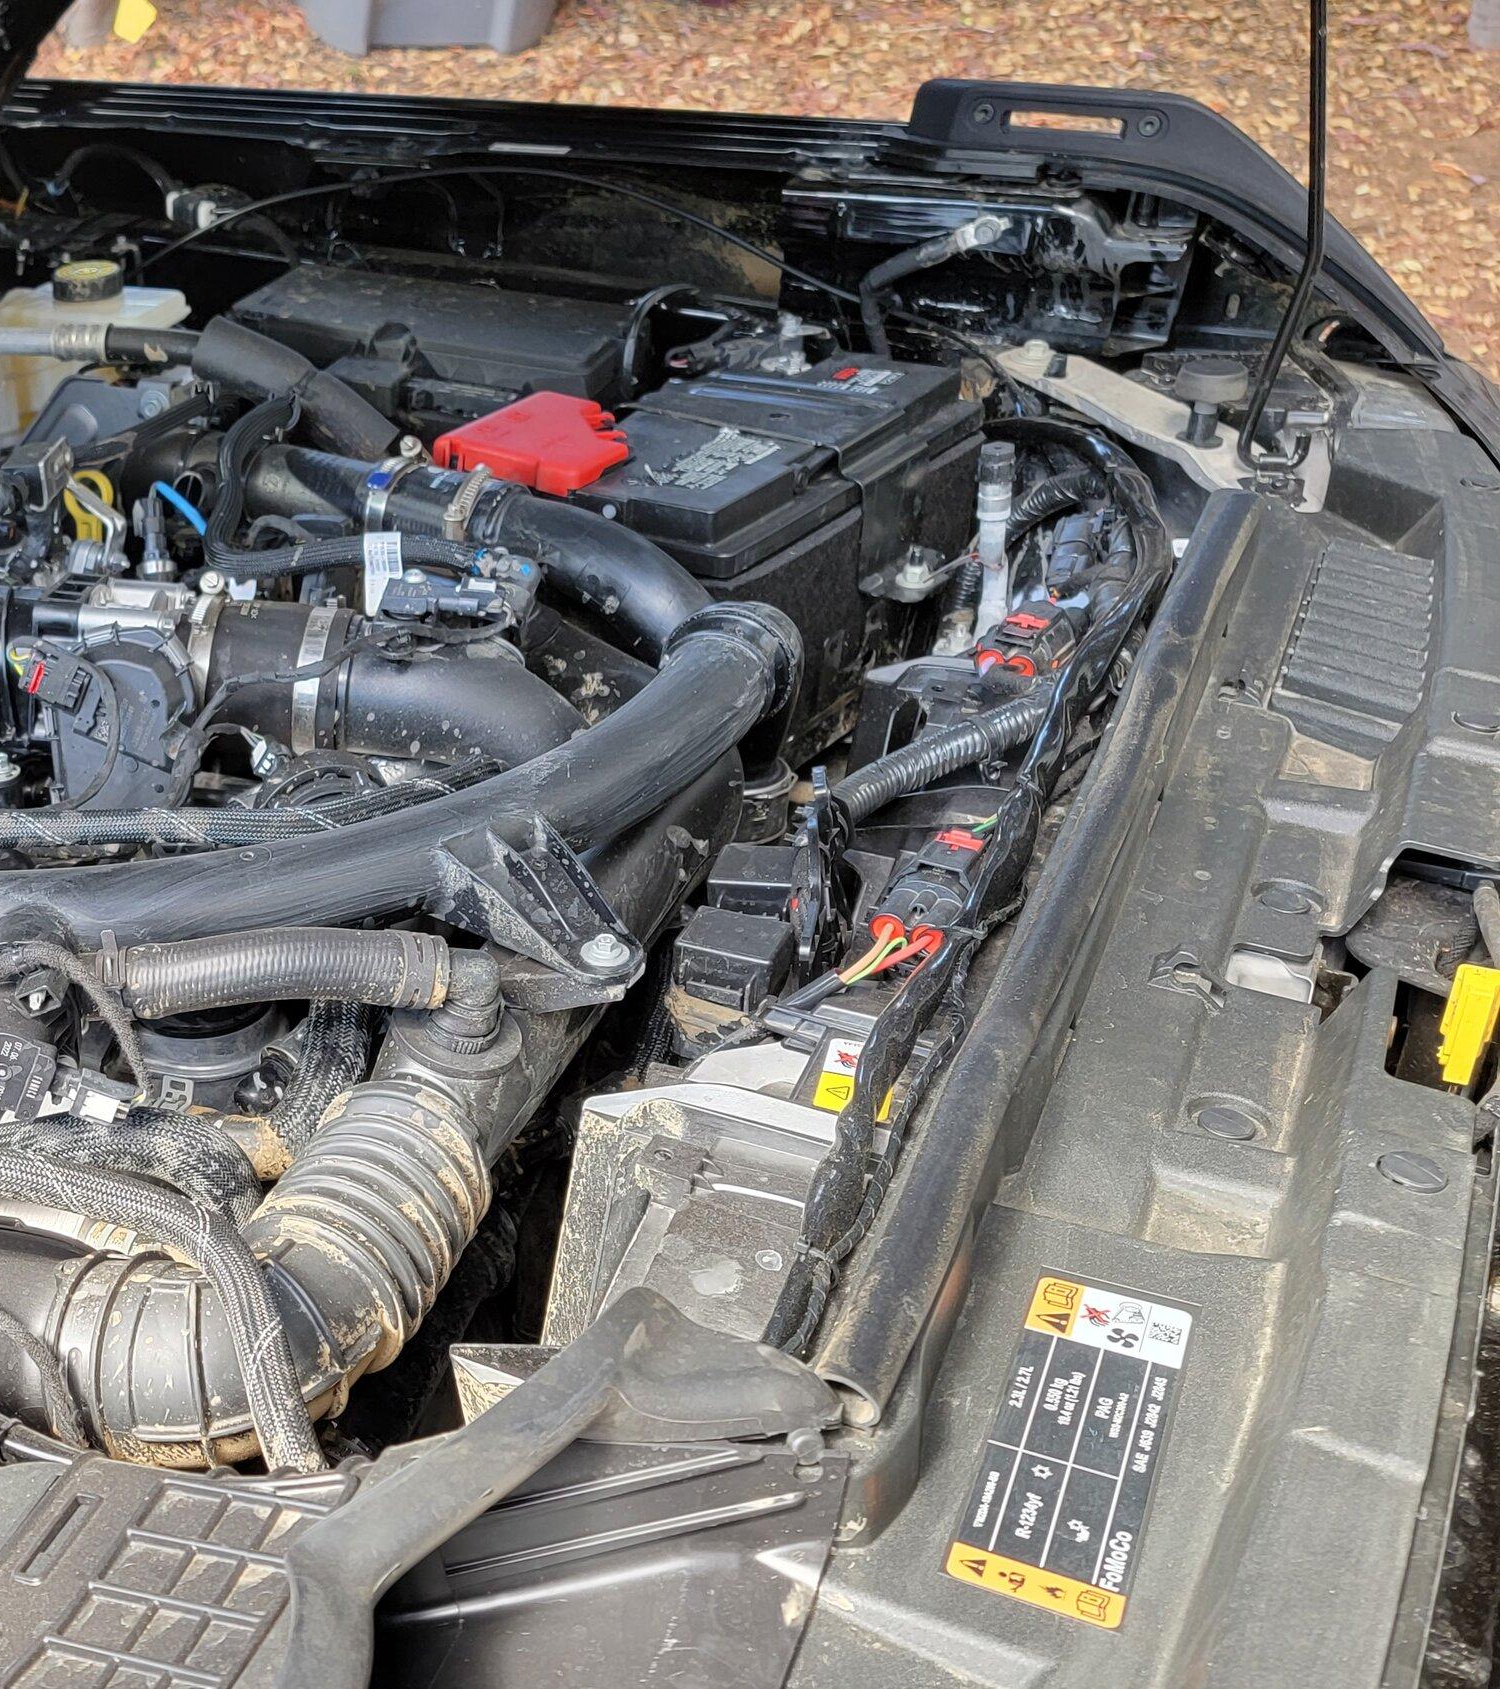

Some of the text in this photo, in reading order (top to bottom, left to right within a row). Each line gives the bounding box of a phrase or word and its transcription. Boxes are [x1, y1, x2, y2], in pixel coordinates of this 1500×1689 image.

[1, 1041, 13, 1057] 2022
[1016, 1366, 1034, 1385] 2.7L
[1050, 1377, 1069, 1391] kg
[1008, 1389, 1027, 1408] 2.3L
[1094, 1396, 1114, 1419] PAG
[1138, 1430, 1155, 1451] J639
[1132, 1452, 1150, 1473] SAE
[1015, 1492, 1044, 1539] R-1234yf
[1099, 1531, 1133, 1592] FoMoCo
